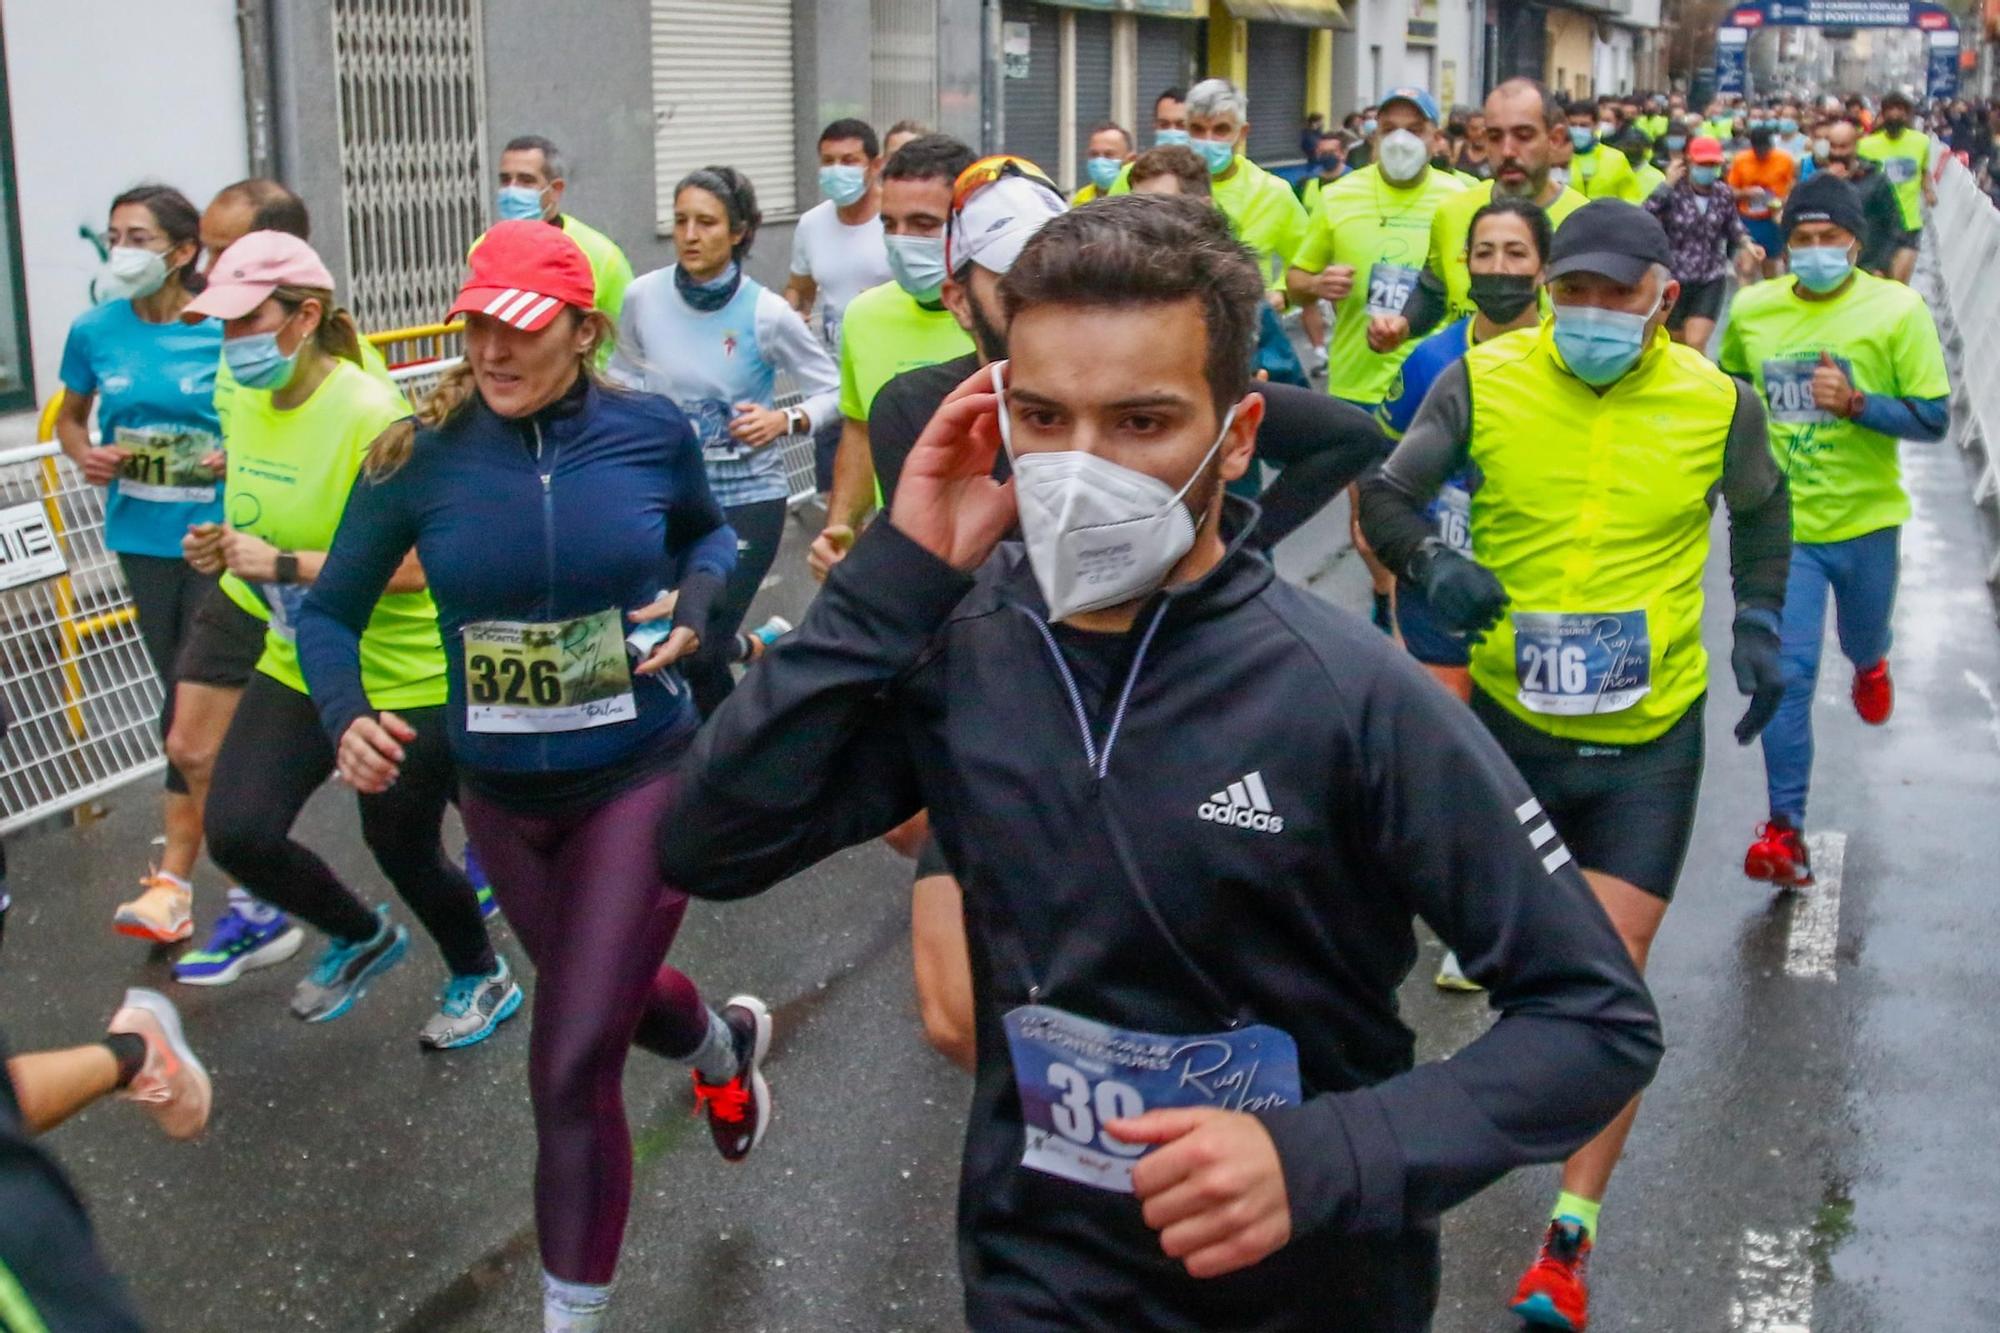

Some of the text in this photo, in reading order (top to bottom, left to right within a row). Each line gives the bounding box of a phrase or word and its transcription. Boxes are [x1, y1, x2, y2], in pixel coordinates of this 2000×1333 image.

[1808, 11, 1823, 21] DE
[1825, 11, 1910, 22] PONTECESURES
[1370, 279, 1410, 311] 215
[470, 655, 562, 706] 326
[1523, 644, 1587, 694] 216
[1197, 802, 1285, 834] adidas
[1169, 1039, 1246, 1100] Run
